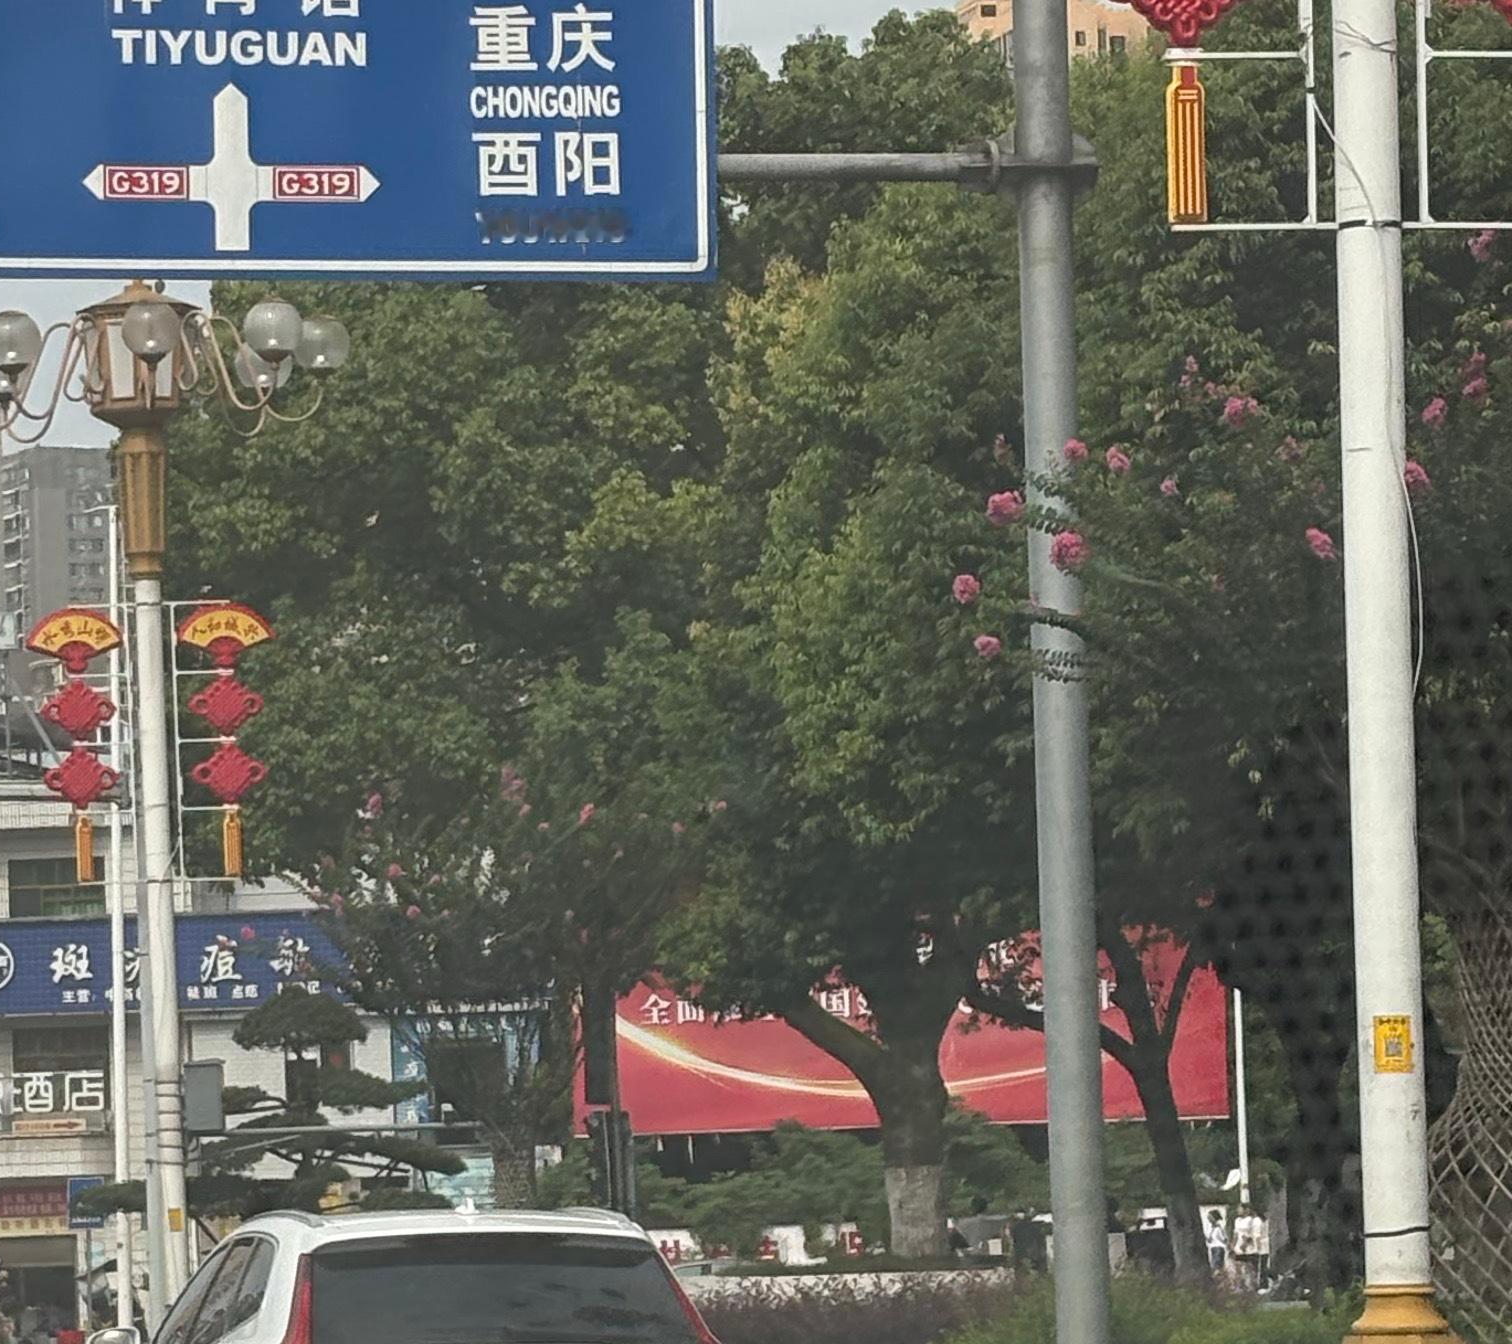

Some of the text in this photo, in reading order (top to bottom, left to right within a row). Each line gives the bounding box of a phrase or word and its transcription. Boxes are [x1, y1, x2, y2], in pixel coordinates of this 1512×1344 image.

[111, 29, 367, 67] TIYUGUAN
[468, 2, 617, 73] 重庆
[469, 84, 621, 120] CHONGQING
[111, 171, 181, 194] G319
[471, 131, 621, 197] 酉阳
[281, 172, 351, 195] G319
